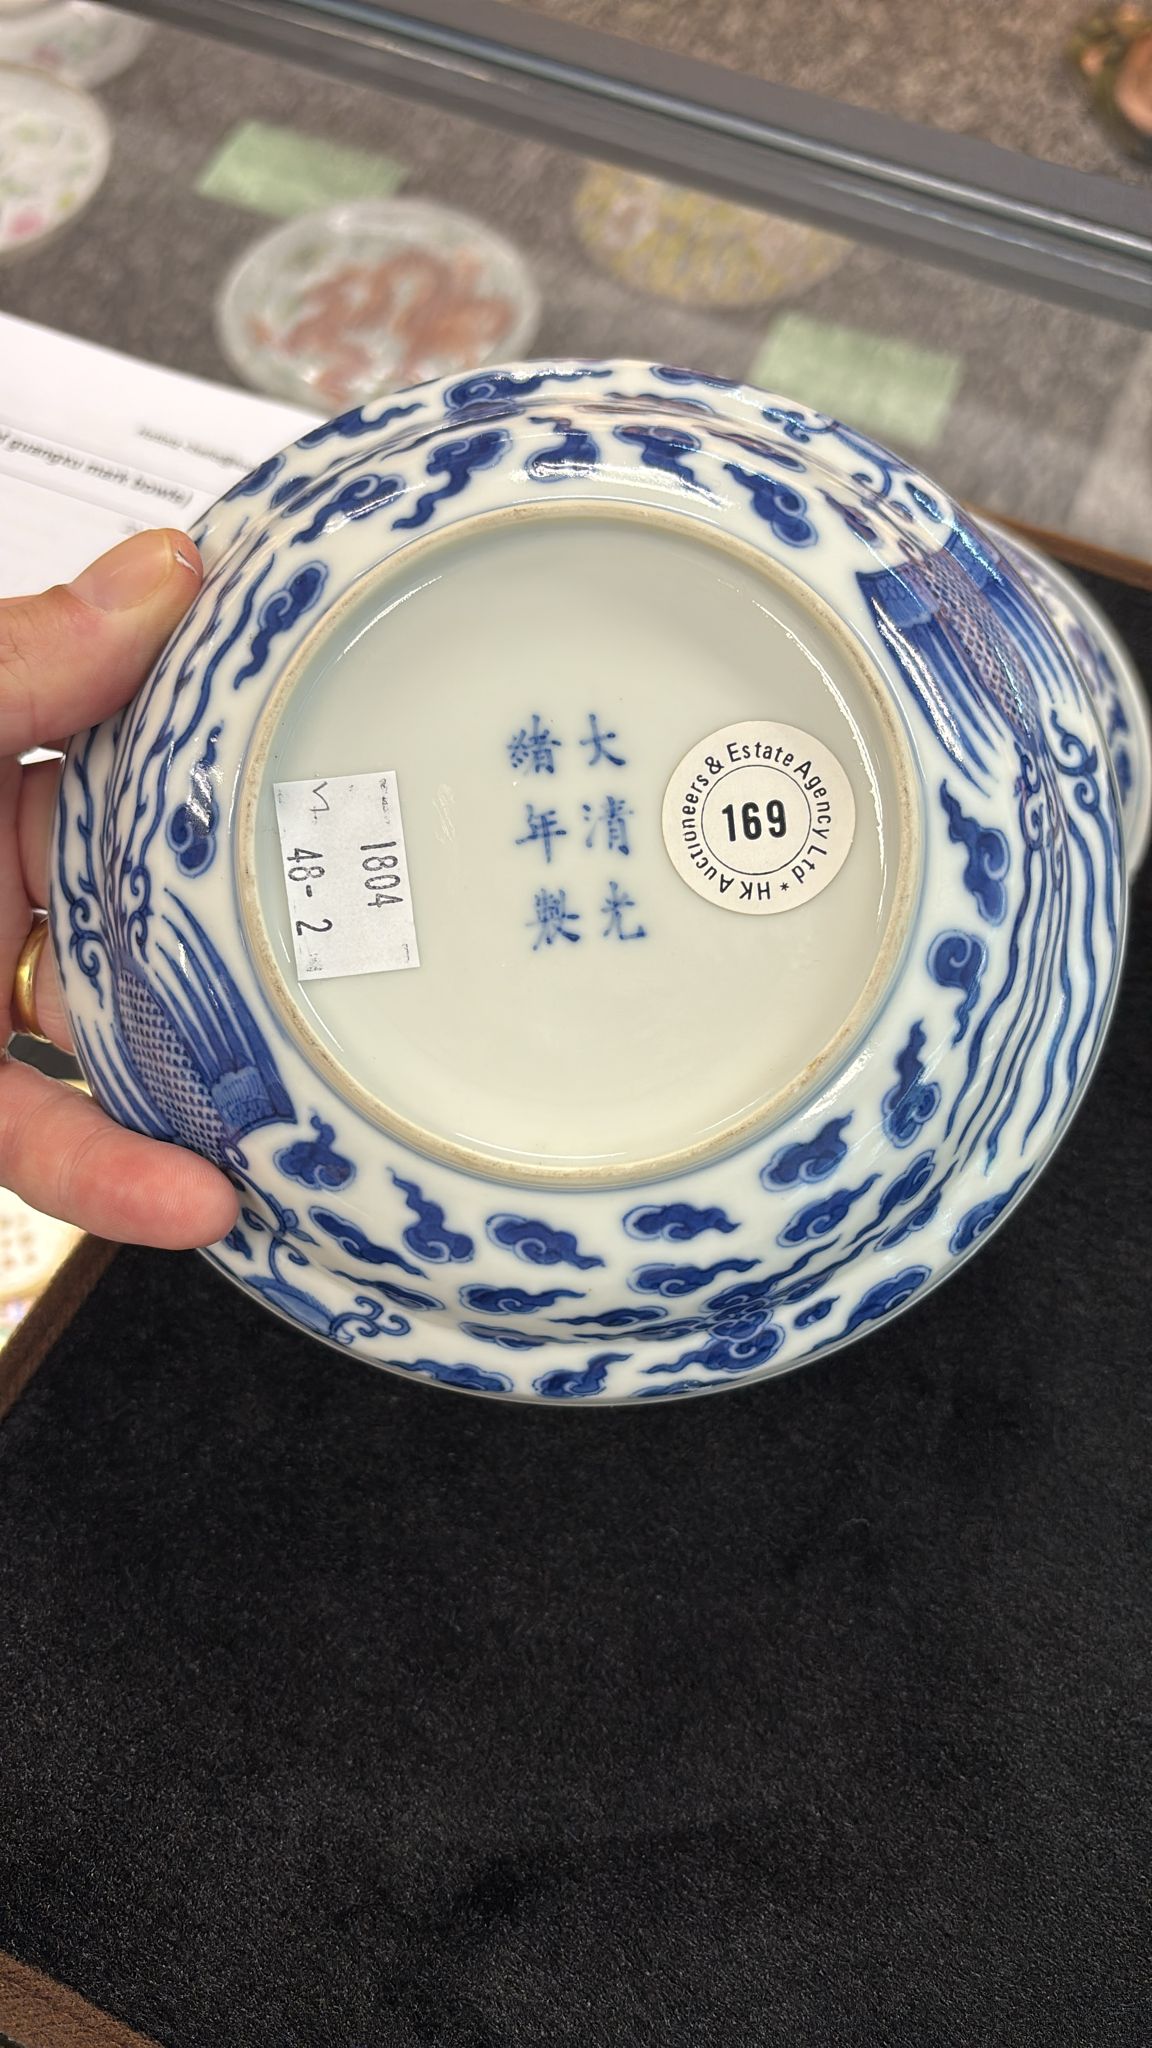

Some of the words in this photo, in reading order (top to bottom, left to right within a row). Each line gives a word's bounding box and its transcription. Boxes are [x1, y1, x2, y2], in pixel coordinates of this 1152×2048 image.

[704, 756, 724, 774] &
[726, 742, 794, 767] Estate
[721, 799, 787, 842] 169
[793, 760, 832, 840] Agency
[682, 774, 735, 893] Auctioneers
[360, 841, 404, 908] 1804
[791, 844, 827, 884] Ltd
[739, 881, 771, 900] HK
